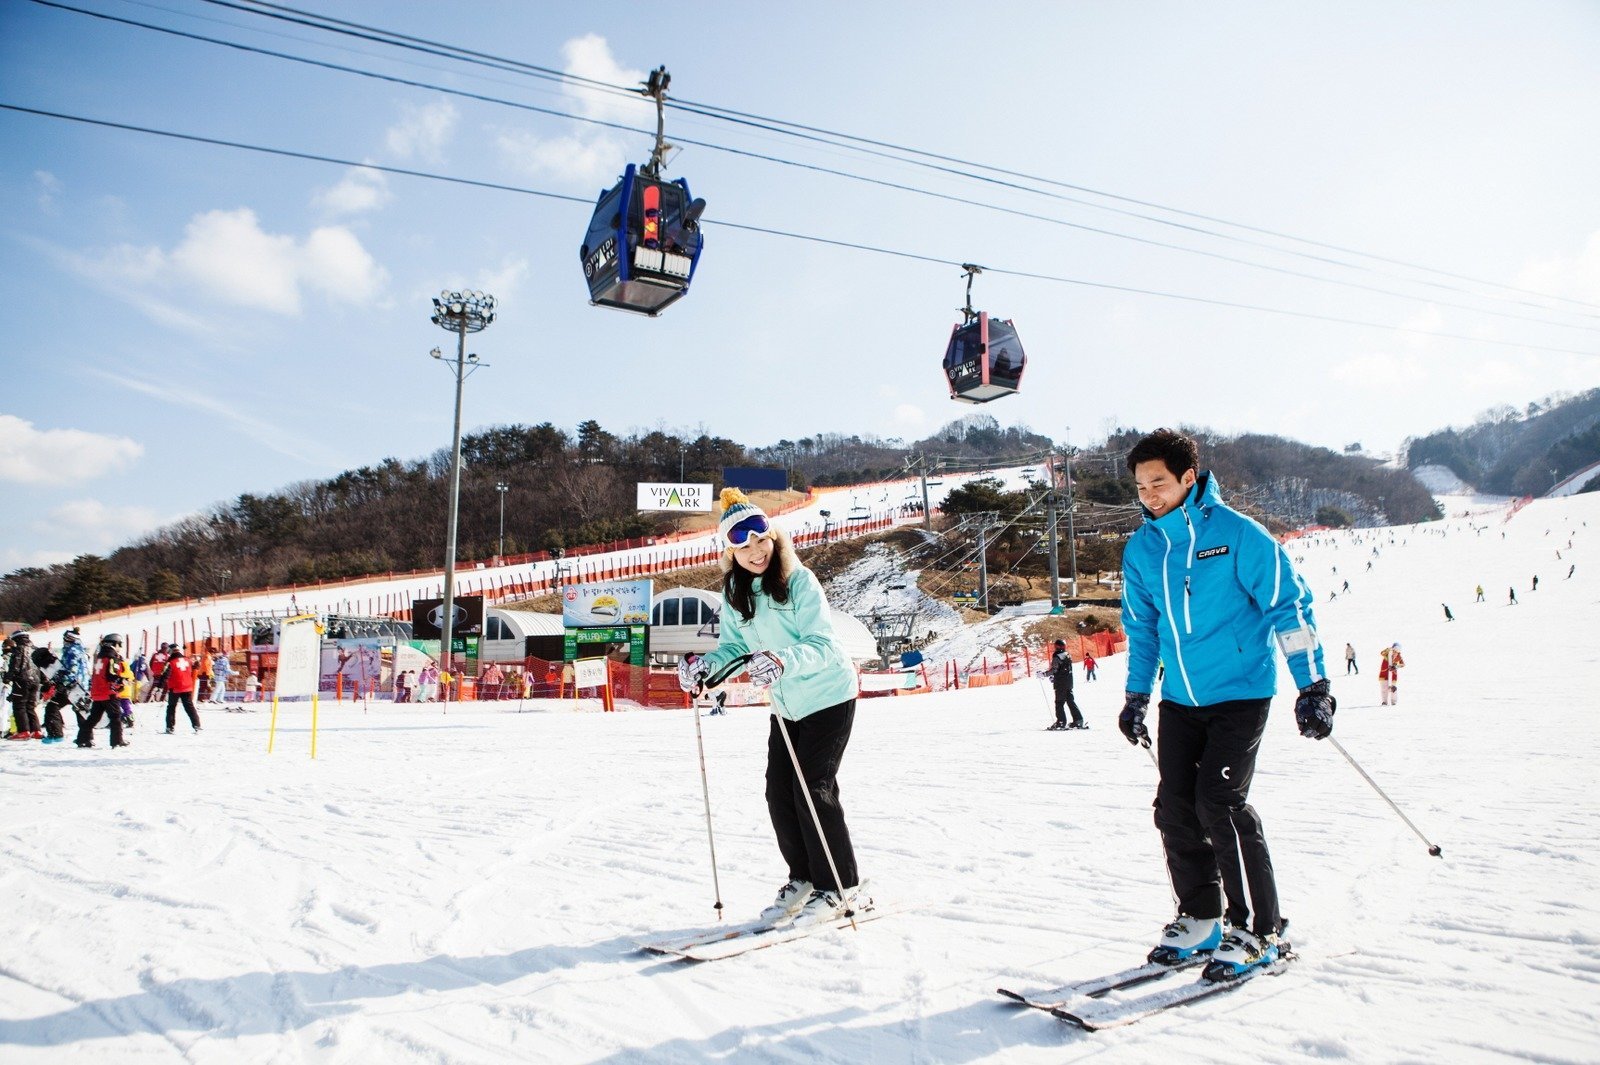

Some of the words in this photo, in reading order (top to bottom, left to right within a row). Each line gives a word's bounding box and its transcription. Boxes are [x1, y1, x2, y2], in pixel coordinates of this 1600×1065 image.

[954, 360, 976, 373] VIVALDI
[650, 487, 700, 498] VIVALDI
[659, 496, 700, 507] PARK
[1198, 546, 1228, 558] CARVE
[614, 631, 627, 640] 초급
